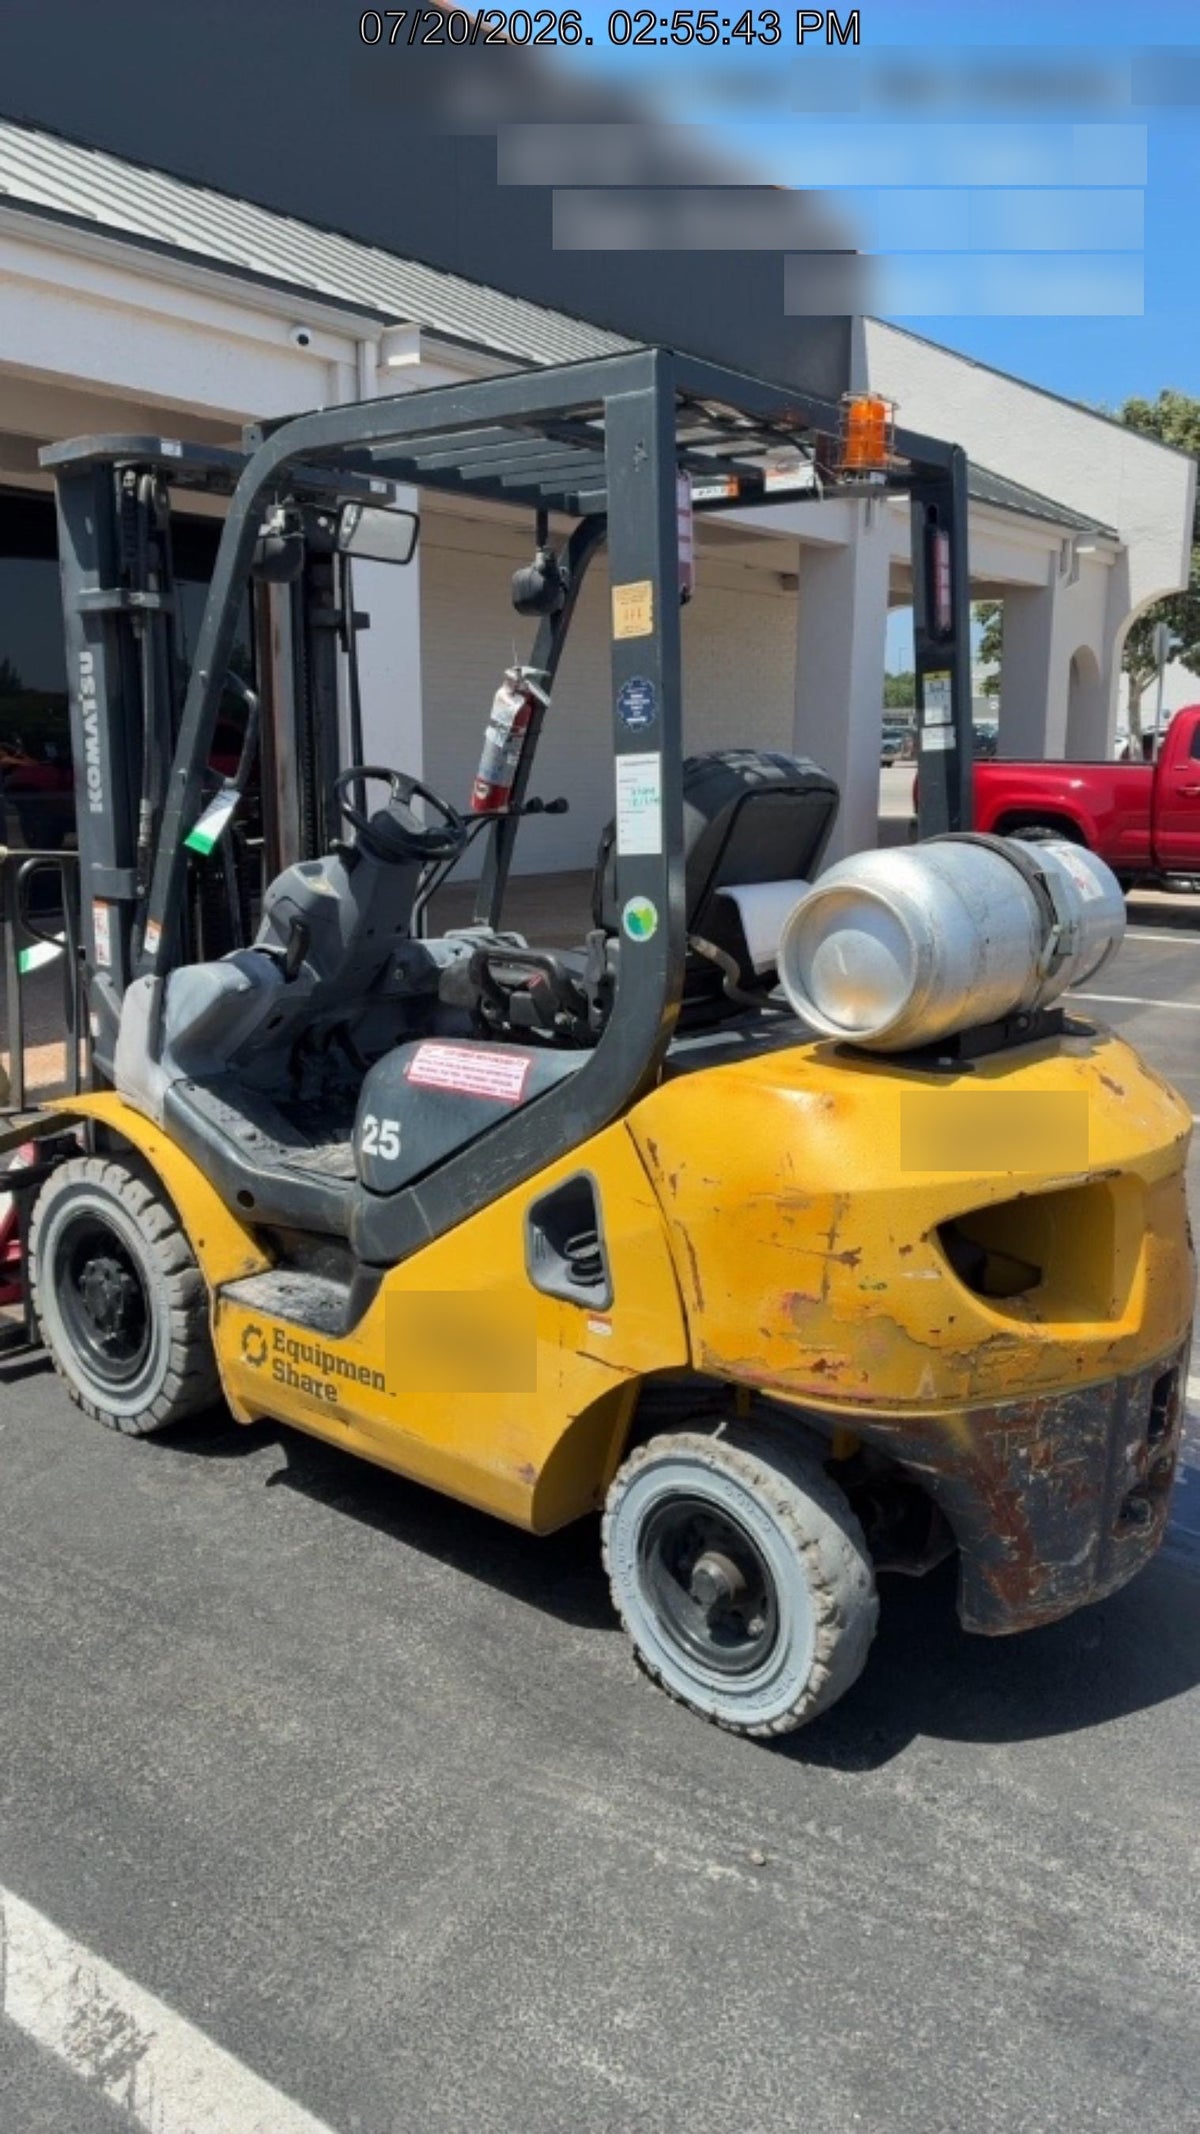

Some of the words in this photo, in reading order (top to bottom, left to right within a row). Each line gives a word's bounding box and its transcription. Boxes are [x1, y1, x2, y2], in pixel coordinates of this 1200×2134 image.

[78, 651, 103, 813] KOMATSU
[362, 1114, 401, 1161] 25
[272, 1327, 397, 1397] Equipmen
[272, 1357, 338, 1402] Share
